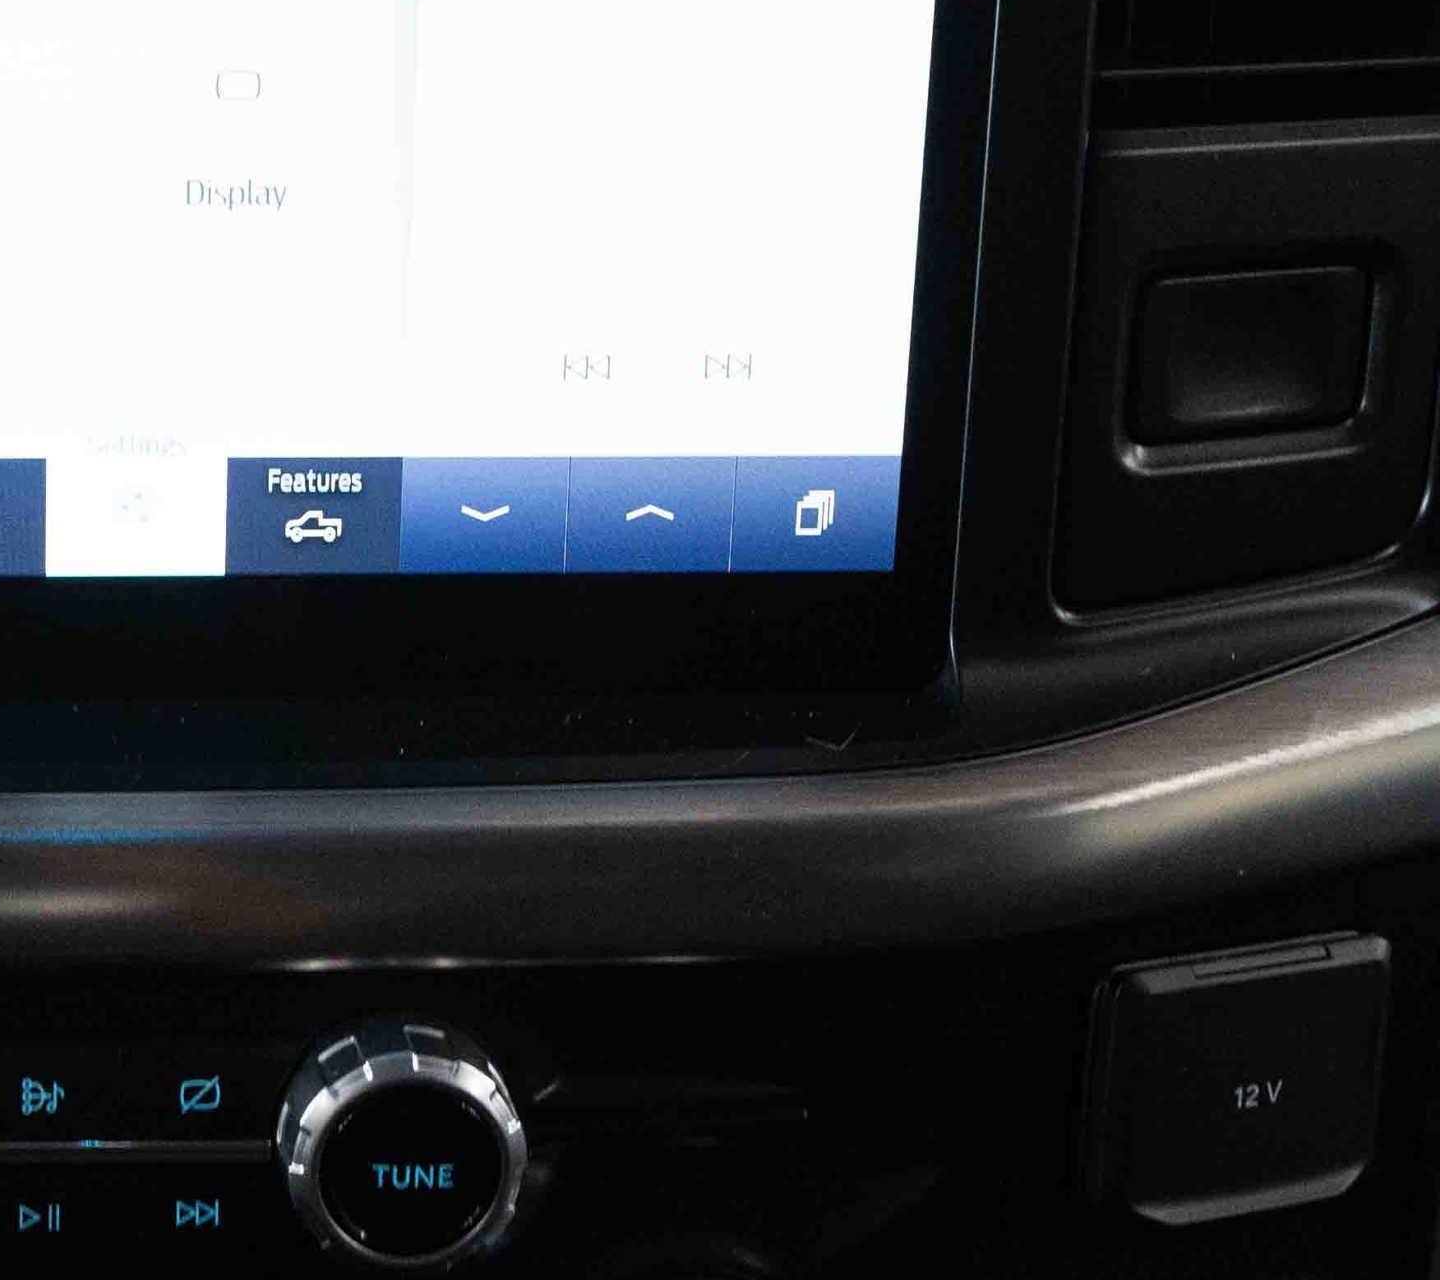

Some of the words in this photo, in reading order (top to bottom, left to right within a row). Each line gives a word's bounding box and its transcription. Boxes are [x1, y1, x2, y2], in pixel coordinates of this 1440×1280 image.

[186, 179, 287, 211] Display
[268, 466, 363, 495] Features
[1234, 1084, 1260, 1109] 12
[1266, 1079, 1283, 1104] V
[372, 1163, 455, 1190] TUNE
